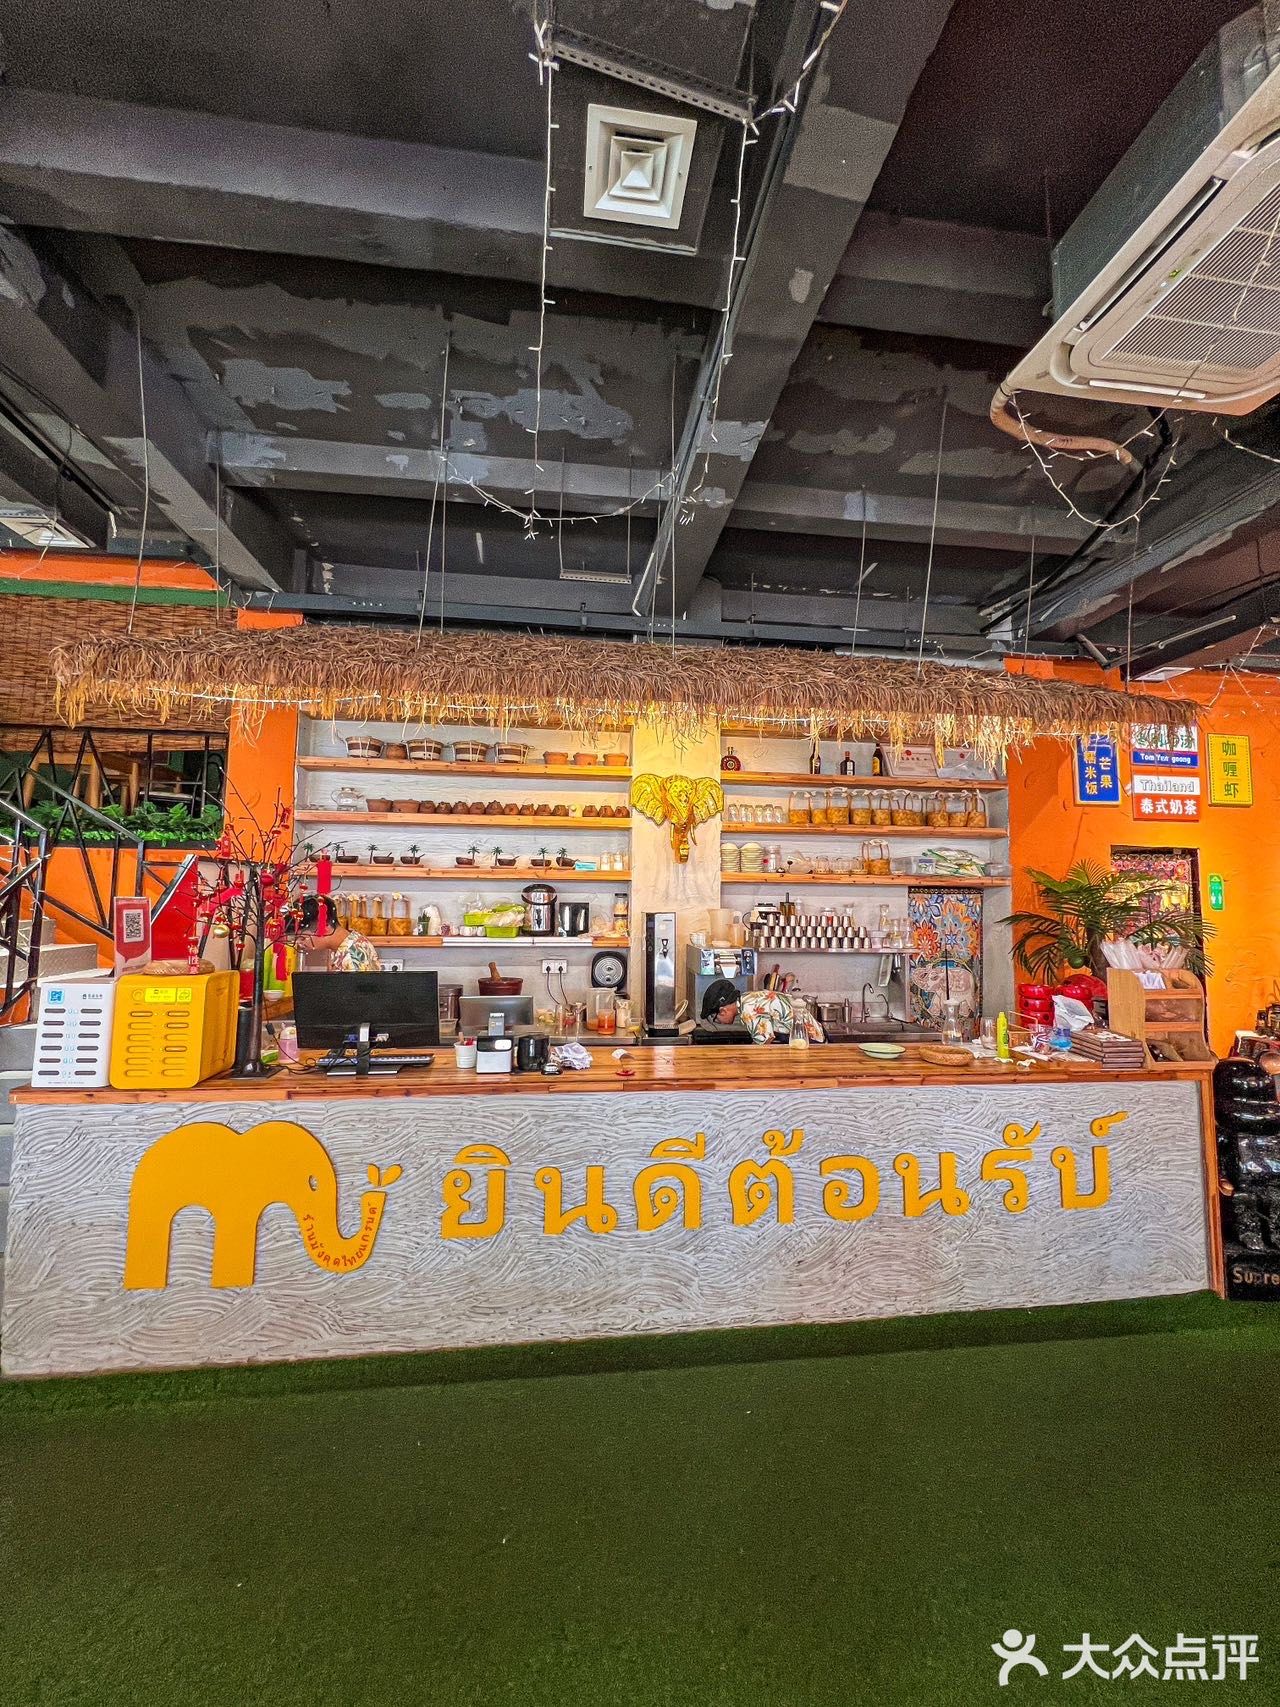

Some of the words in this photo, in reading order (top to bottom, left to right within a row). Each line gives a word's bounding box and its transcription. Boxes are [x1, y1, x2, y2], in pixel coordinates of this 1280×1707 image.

[1140, 753, 1155, 761] Tom
[1171, 756, 1192, 765] goong
[1099, 756, 1112, 788] 芒果
[1221, 741, 1239, 798] 咖喱虾
[1140, 778, 1195, 793] Thailand
[1140, 797, 1197, 815] 泰式奶茶
